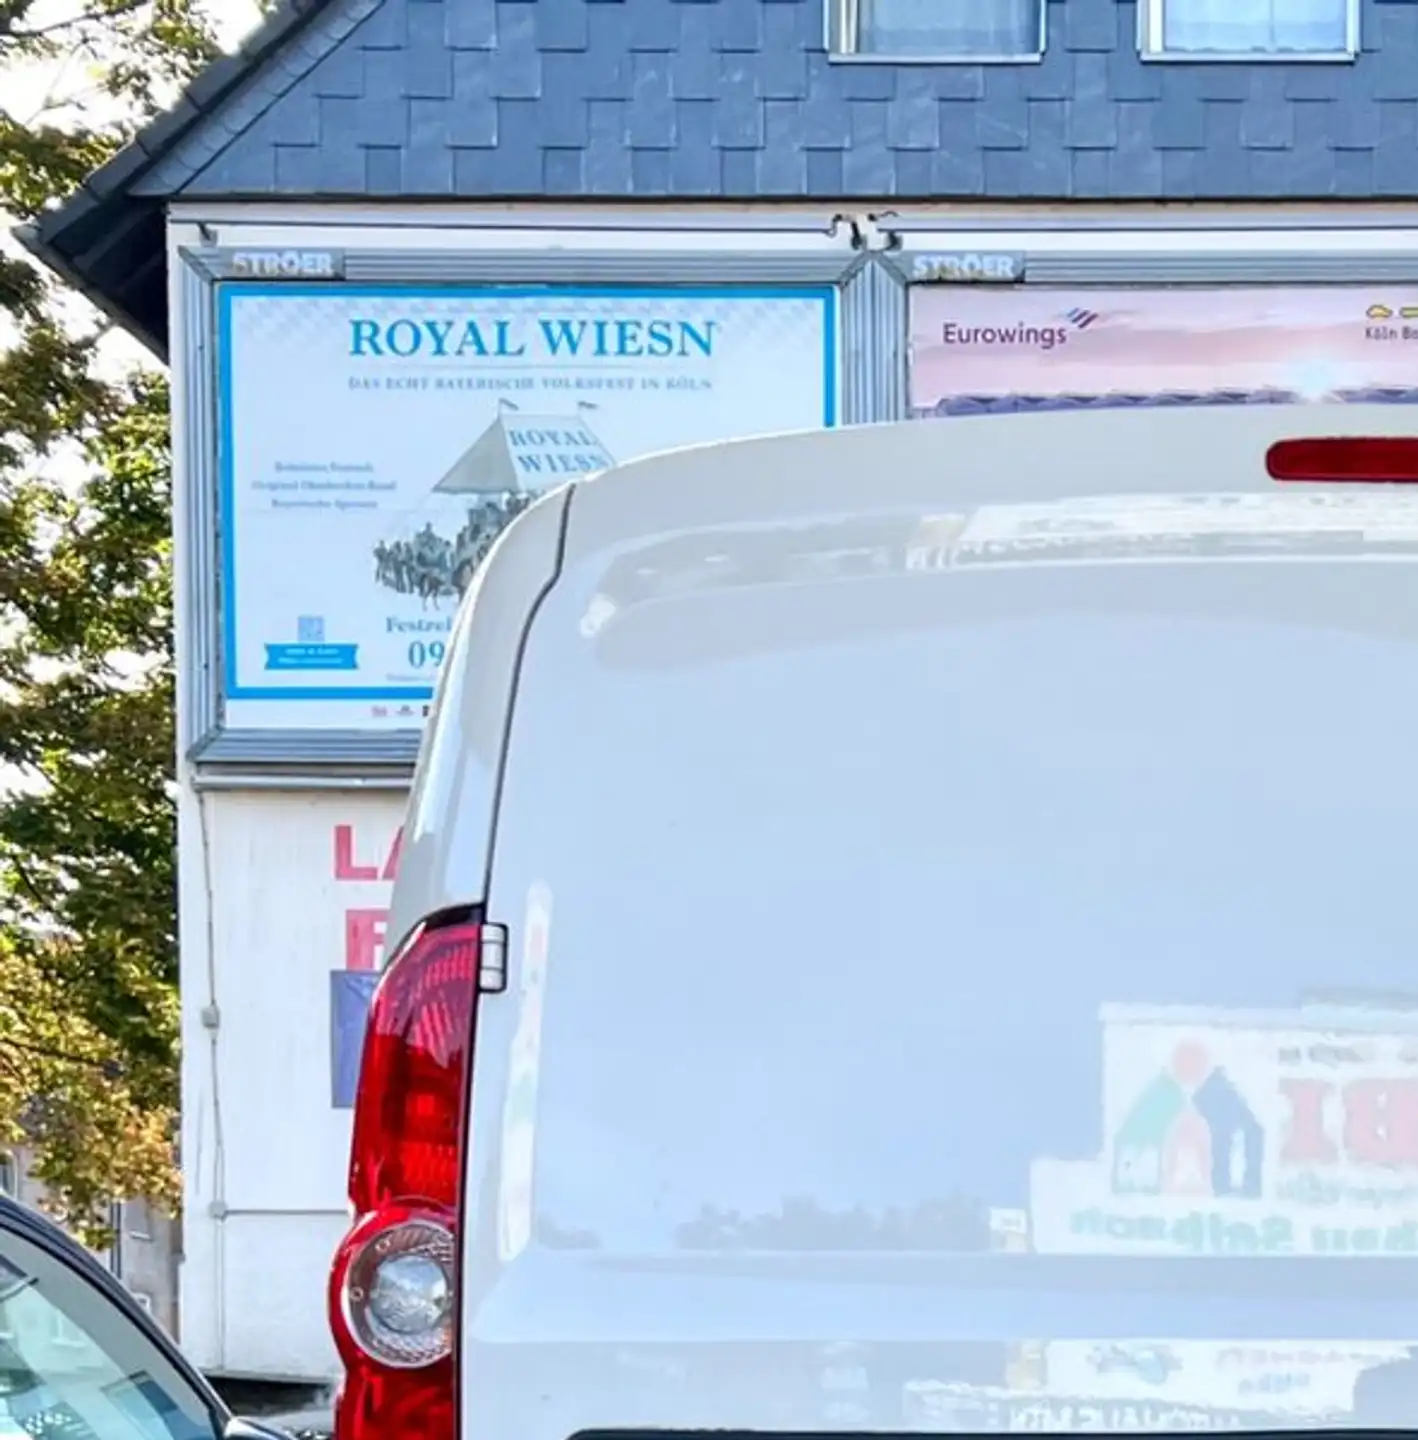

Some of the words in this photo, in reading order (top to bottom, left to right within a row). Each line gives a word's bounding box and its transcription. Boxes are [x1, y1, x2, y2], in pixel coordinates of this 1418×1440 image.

[349, 317, 526, 357] ROYAL
[538, 318, 716, 357] WIESN
[943, 322, 1067, 350] Eurowings
[1365, 326, 1398, 340] Köln
[508, 428, 598, 447] ROYAL
[517, 454, 608, 474] WIESN
